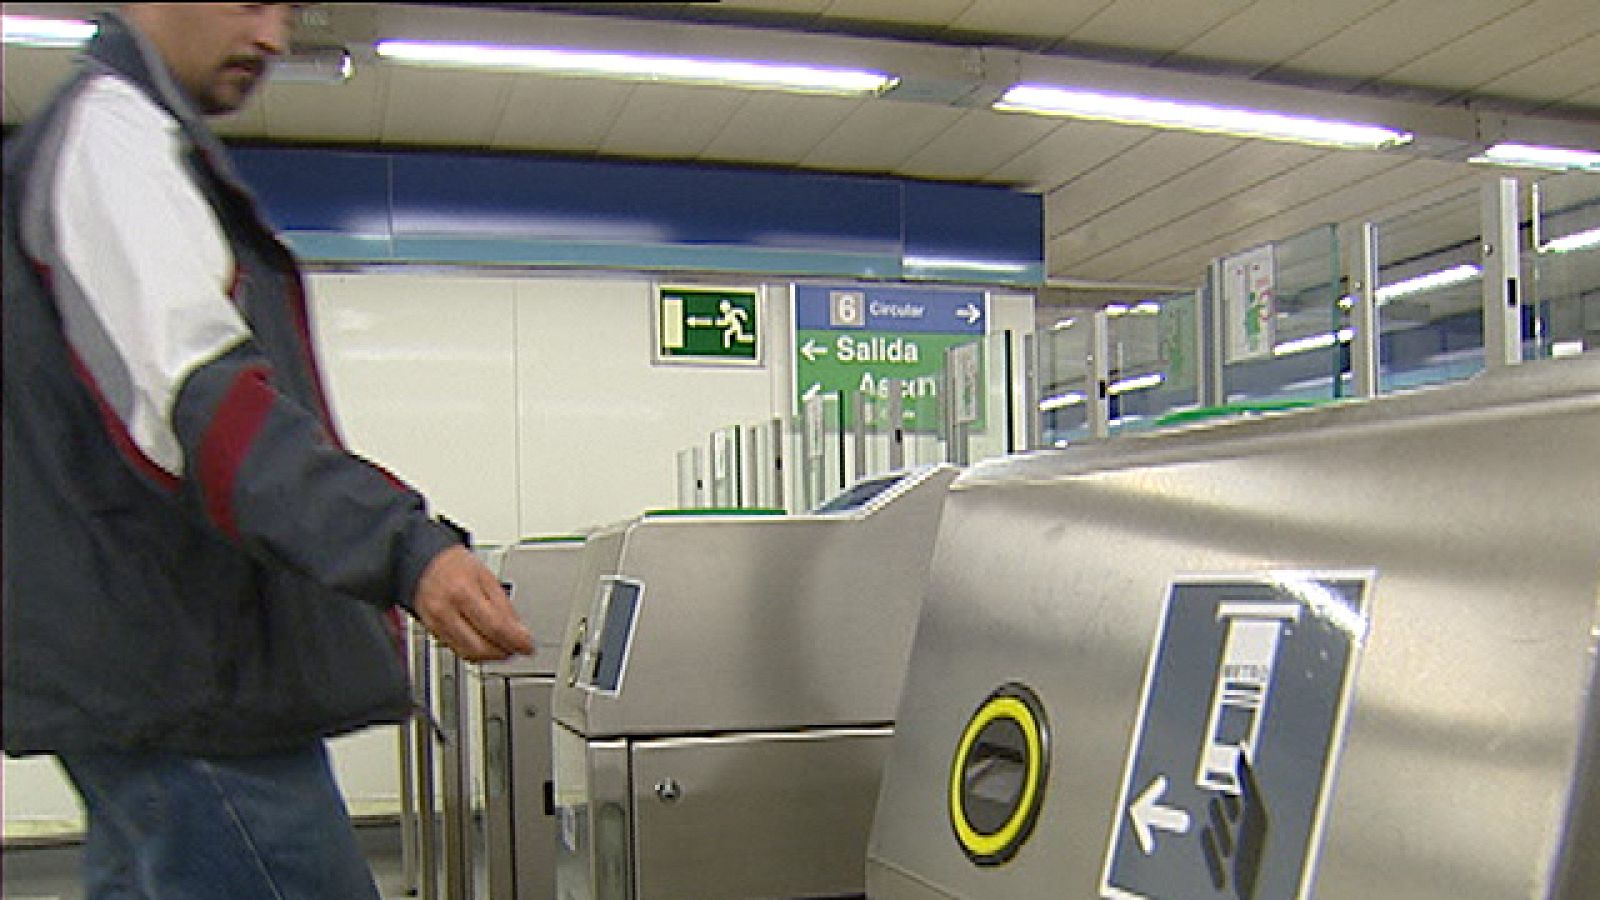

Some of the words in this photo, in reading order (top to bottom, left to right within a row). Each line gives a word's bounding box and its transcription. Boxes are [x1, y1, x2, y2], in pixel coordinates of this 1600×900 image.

[839, 296, 856, 323] 6
[869, 300, 925, 318] Circular
[836, 335, 919, 363] Salida
